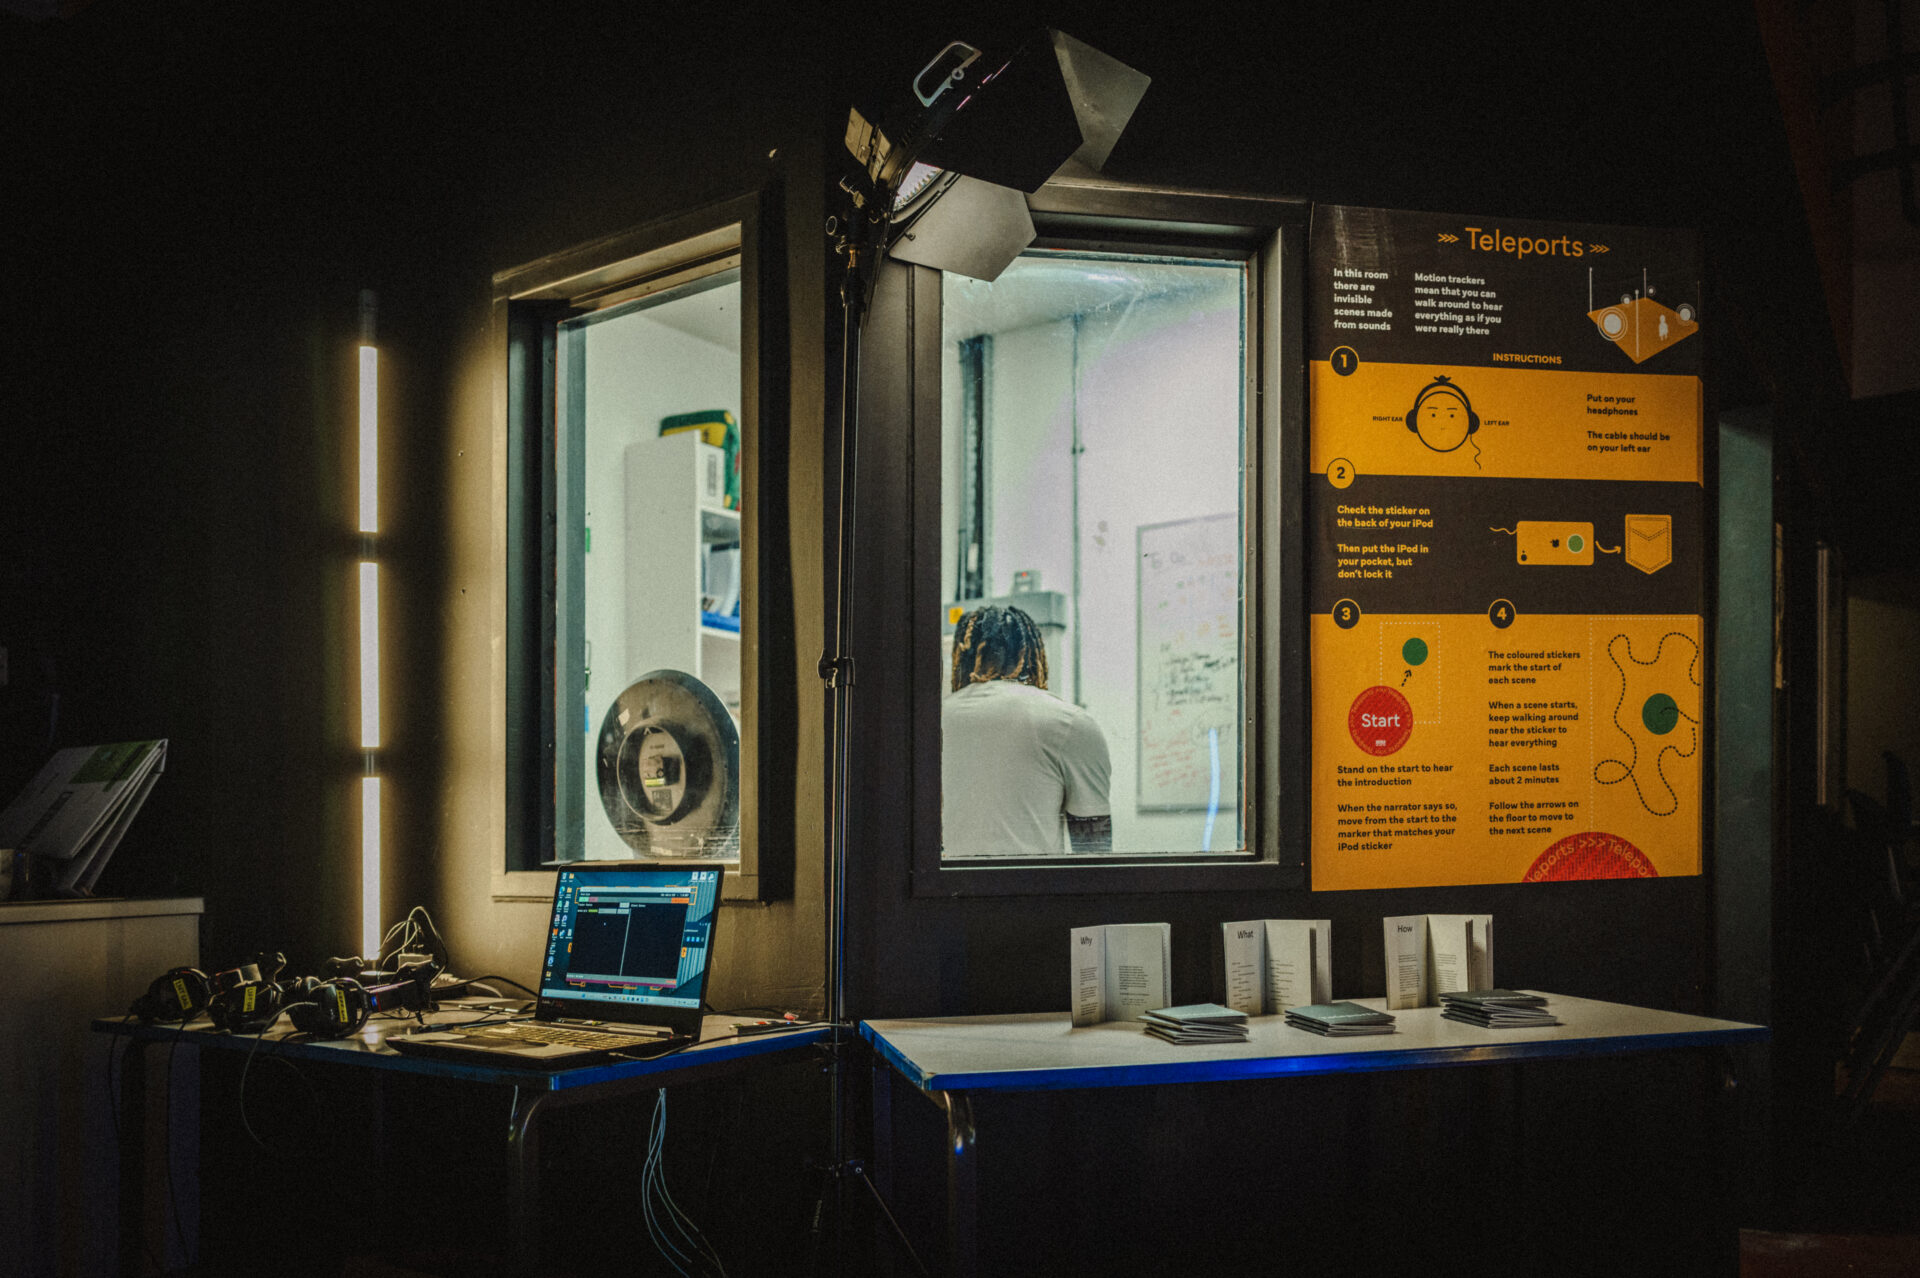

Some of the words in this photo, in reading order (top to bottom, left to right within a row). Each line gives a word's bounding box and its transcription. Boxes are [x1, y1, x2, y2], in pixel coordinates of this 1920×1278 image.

[1464, 226, 1583, 259] Teleports
[1333, 267, 1343, 276] In
[1343, 267, 1362, 277] this
[1364, 271, 1388, 279] room
[1414, 272, 1446, 282] Motion
[1447, 275, 1485, 284] trackers
[1333, 280, 1358, 290] there
[1414, 286, 1439, 294] mean
[1440, 286, 1460, 295] that
[1461, 289, 1478, 298] you
[1479, 290, 1496, 298] can
[1333, 293, 1372, 304] invisible
[1414, 298, 1436, 307] walk
[1438, 300, 1469, 308] around
[1471, 301, 1481, 309] to
[1482, 301, 1502, 310] hear
[1333, 308, 1365, 316] scenes
[1366, 308, 1392, 317] made
[1414, 311, 1463, 323] everything
[1465, 314, 1475, 322] as
[1476, 313, 1484, 322] if
[1484, 316, 1501, 324] you
[1333, 319, 1356, 328] from
[1358, 321, 1390, 330] sounds
[1438, 324, 1464, 335] really
[1465, 325, 1489, 334] there
[1340, 353, 1346, 367] 1
[1492, 352, 1561, 364] INSTRUCTIONS
[1586, 393, 1602, 402] Put
[1615, 396, 1635, 404] your
[1586, 406, 1638, 416] headphones
[1586, 430, 1602, 439] The
[1604, 431, 1627, 440] cable
[1629, 431, 1657, 440] should
[1659, 432, 1670, 441] be
[1599, 445, 1618, 453] your
[1620, 443, 1635, 452] left
[1336, 466, 1345, 479] 2
[1336, 504, 1366, 514] Check
[1367, 505, 1383, 514] the
[1385, 505, 1417, 514] sticker
[1336, 517, 1352, 527] the
[1354, 517, 1376, 527] back
[1378, 518, 1388, 527] of
[1389, 520, 1411, 529] your
[1412, 518, 1433, 527] iPod
[1336, 543, 1360, 552] Then
[1361, 544, 1378, 554] put
[1379, 543, 1395, 552] the
[1397, 544, 1418, 552] iPod
[1419, 544, 1428, 552] in
[1337, 558, 1359, 567] your
[1360, 556, 1394, 567] pocket,
[1396, 556, 1412, 566] but
[1363, 569, 1383, 578] lock
[1384, 569, 1392, 578] it
[1341, 606, 1350, 620] 3
[1496, 607, 1507, 620] 4
[1487, 650, 1504, 658] The
[1506, 650, 1544, 659] coloured
[1546, 650, 1580, 658] stickers
[1488, 663, 1511, 671] mark
[1513, 662, 1527, 671] the
[1529, 663, 1550, 671] start
[1552, 662, 1562, 670] of
[1488, 675, 1509, 684] each
[1488, 700, 1514, 709] When
[1550, 700, 1577, 709] starts,
[1361, 713, 1400, 727] Start
[1488, 713, 1510, 723] keep
[1511, 712, 1546, 723] walking
[1548, 712, 1578, 721] around
[1509, 726, 1524, 734] the
[1526, 725, 1556, 734] sticker
[1488, 738, 1508, 747] hear
[1510, 737, 1557, 748] everything
[1337, 764, 1364, 773] Stand
[1379, 764, 1395, 773] the
[1397, 764, 1419, 772] start
[1421, 764, 1431, 772] to
[1433, 763, 1453, 772] hear
[1488, 763, 1510, 772] Each
[1538, 762, 1559, 771] lasts
[1336, 778, 1352, 786] the
[1354, 777, 1411, 786] introduction
[1488, 776, 1514, 784] about
[1516, 775, 1522, 784] 2
[1524, 775, 1559, 784] minutes
[1337, 803, 1364, 812] When
[1366, 803, 1382, 811] the
[1383, 803, 1421, 811] narrator
[1422, 803, 1442, 812] says
[1488, 801, 1518, 809] Follow
[1519, 800, 1534, 808] the
[1364, 816, 1386, 824] from
[1388, 815, 1404, 824] the
[1406, 815, 1428, 823] start
[1430, 814, 1439, 822] to
[1441, 813, 1456, 822] the
[1489, 813, 1504, 822] the
[1505, 813, 1526, 822] floor
[1527, 813, 1537, 821] to
[1564, 812, 1573, 820] to
[1337, 829, 1370, 837] marker
[1372, 828, 1392, 836] that
[1394, 827, 1433, 836] matches
[1434, 828, 1455, 837] your
[1488, 826, 1504, 835] the
[1505, 826, 1525, 834] next
[1337, 842, 1358, 851] iPod
[1360, 841, 1392, 850] sticker
[1397, 925, 1413, 933] How
[1237, 930, 1254, 940] What
[1080, 936, 1093, 946] Why
